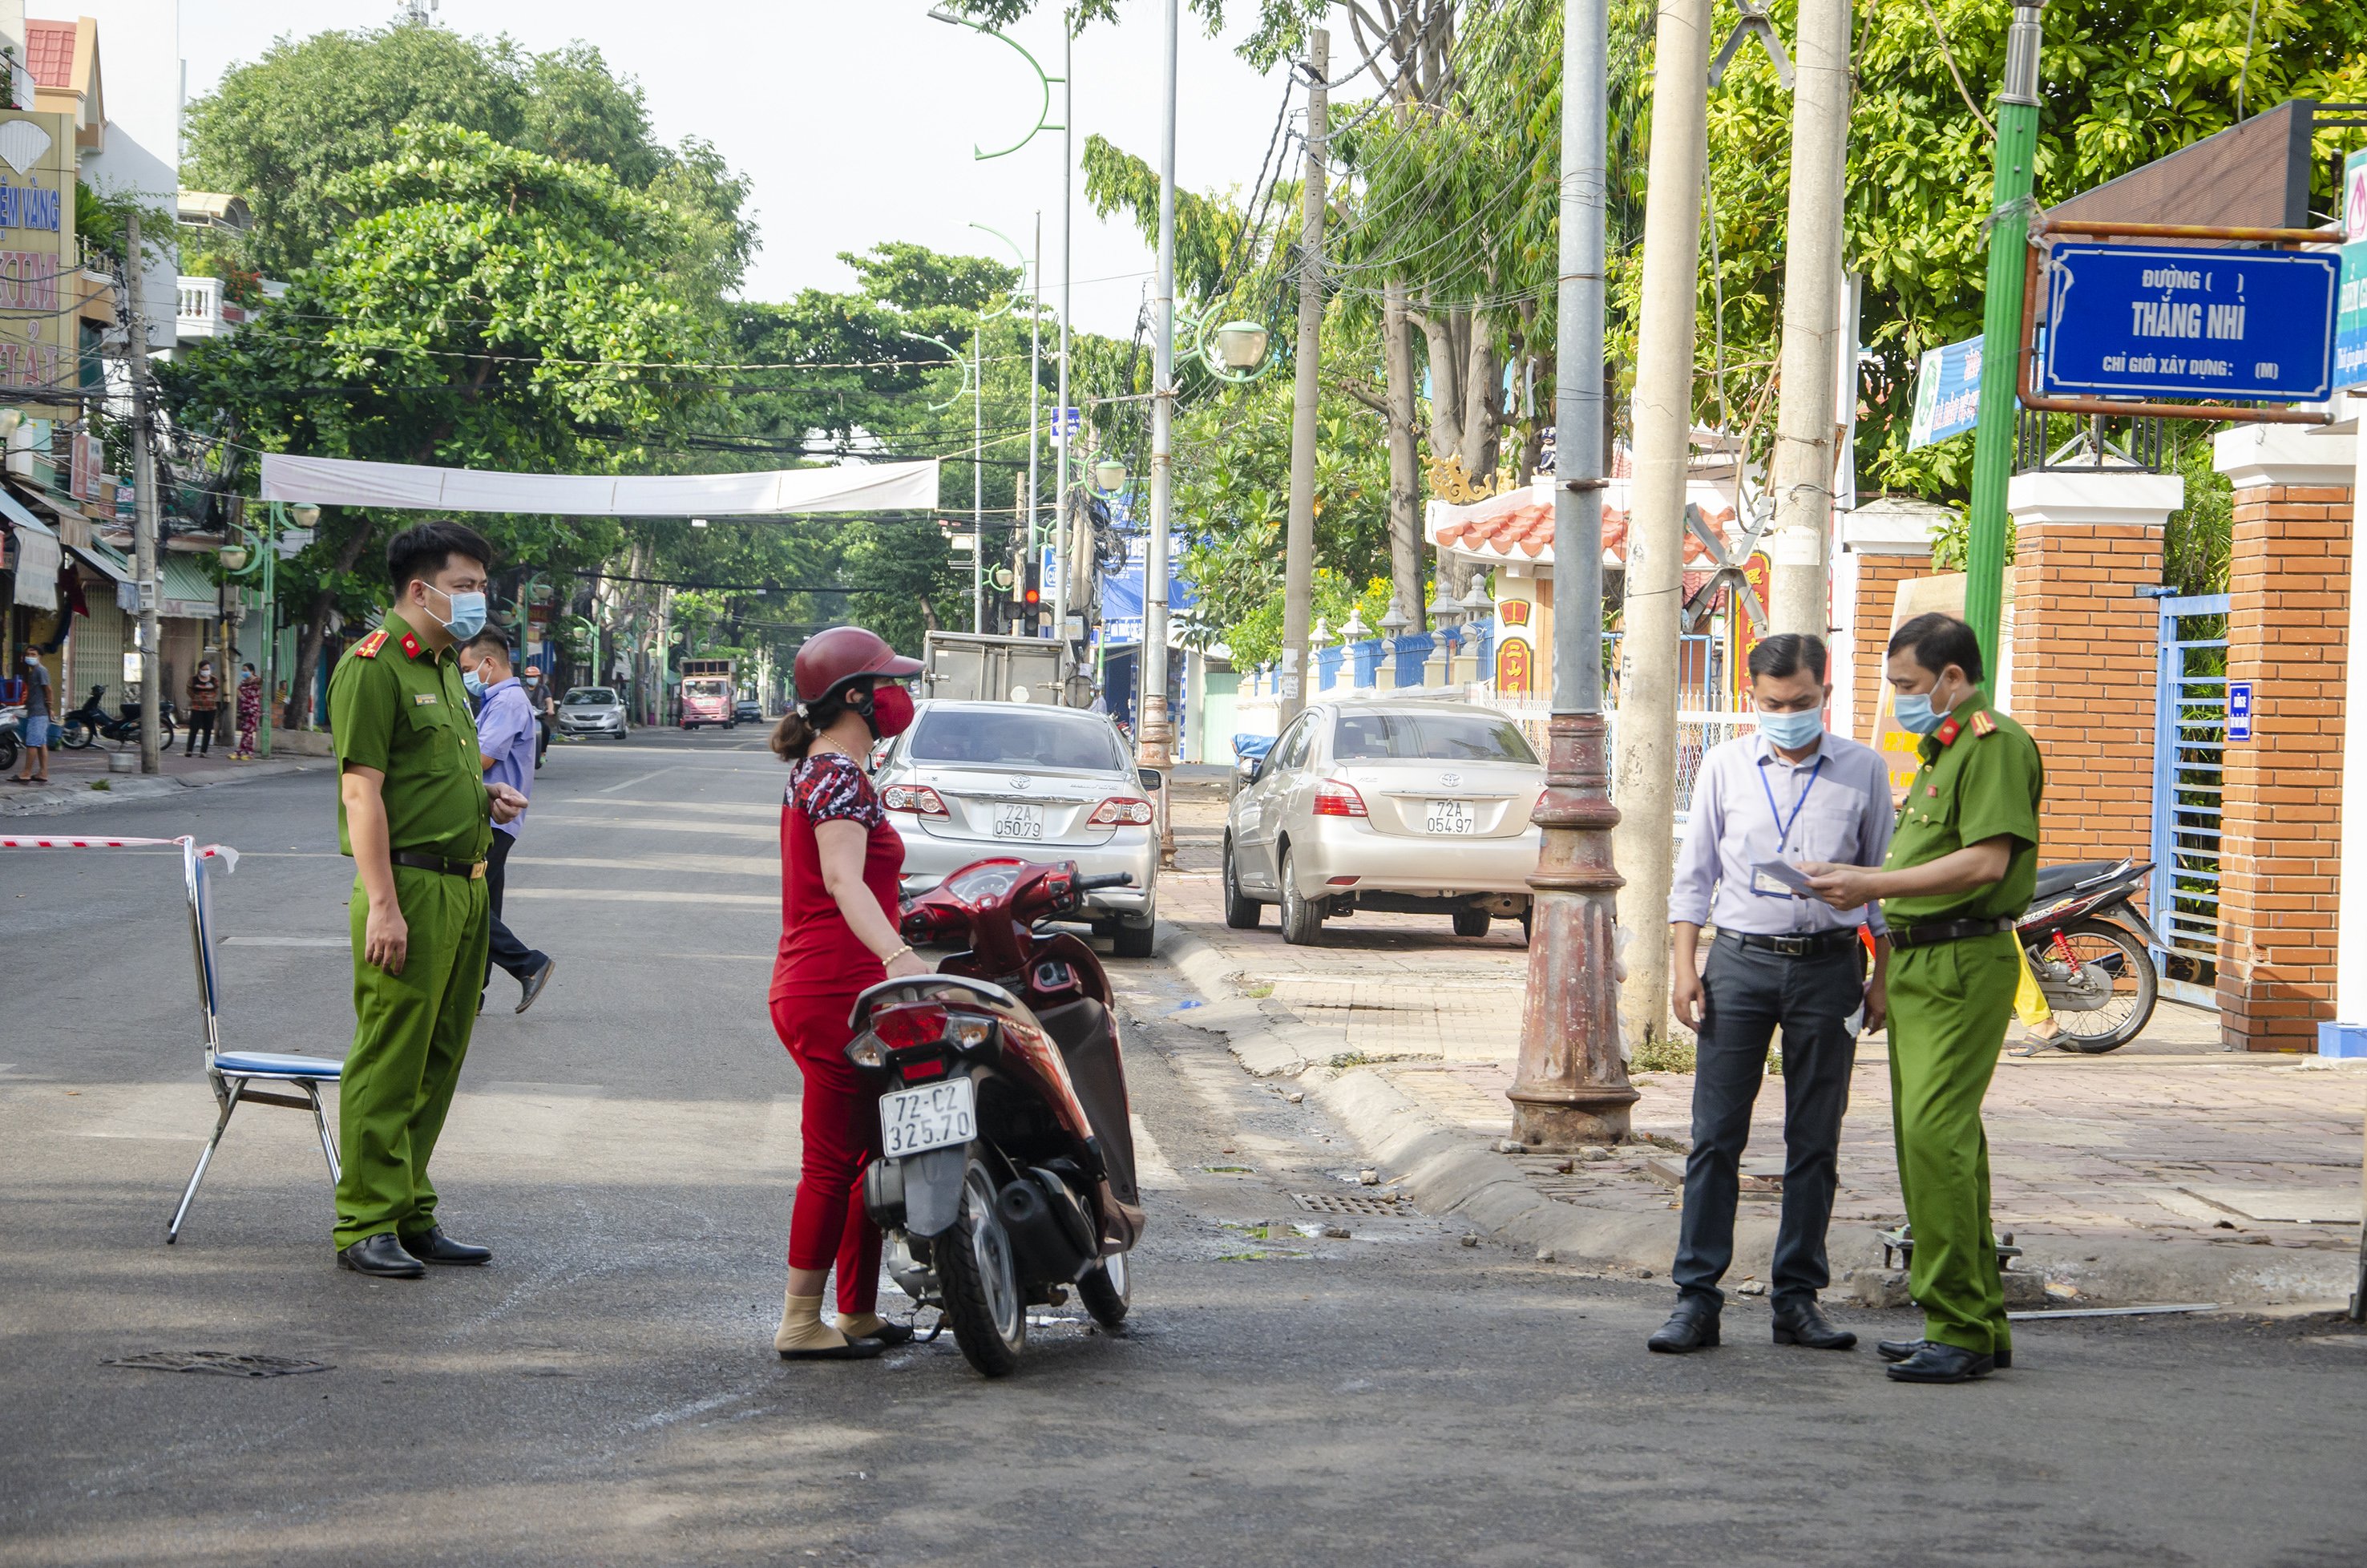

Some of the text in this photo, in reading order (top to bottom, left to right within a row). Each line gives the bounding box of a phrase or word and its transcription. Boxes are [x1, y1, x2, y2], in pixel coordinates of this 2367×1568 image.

[21, 176, 59, 231] VÀNG
[2142, 264, 2201, 289] ĐƯỜNG
[2131, 289, 2246, 340] THẮNG NHÌ
[2102, 351, 2279, 380] CHỈ GIỚI XÂY DỰNG: (M)
[1006, 805, 1031, 821] 72A
[1438, 802, 1462, 817] 72A
[996, 821, 1041, 837] 050.79
[1428, 818, 1472, 833] 054.97
[895, 1085, 958, 1122] 72-C2
[890, 1111, 970, 1152] 325.70
